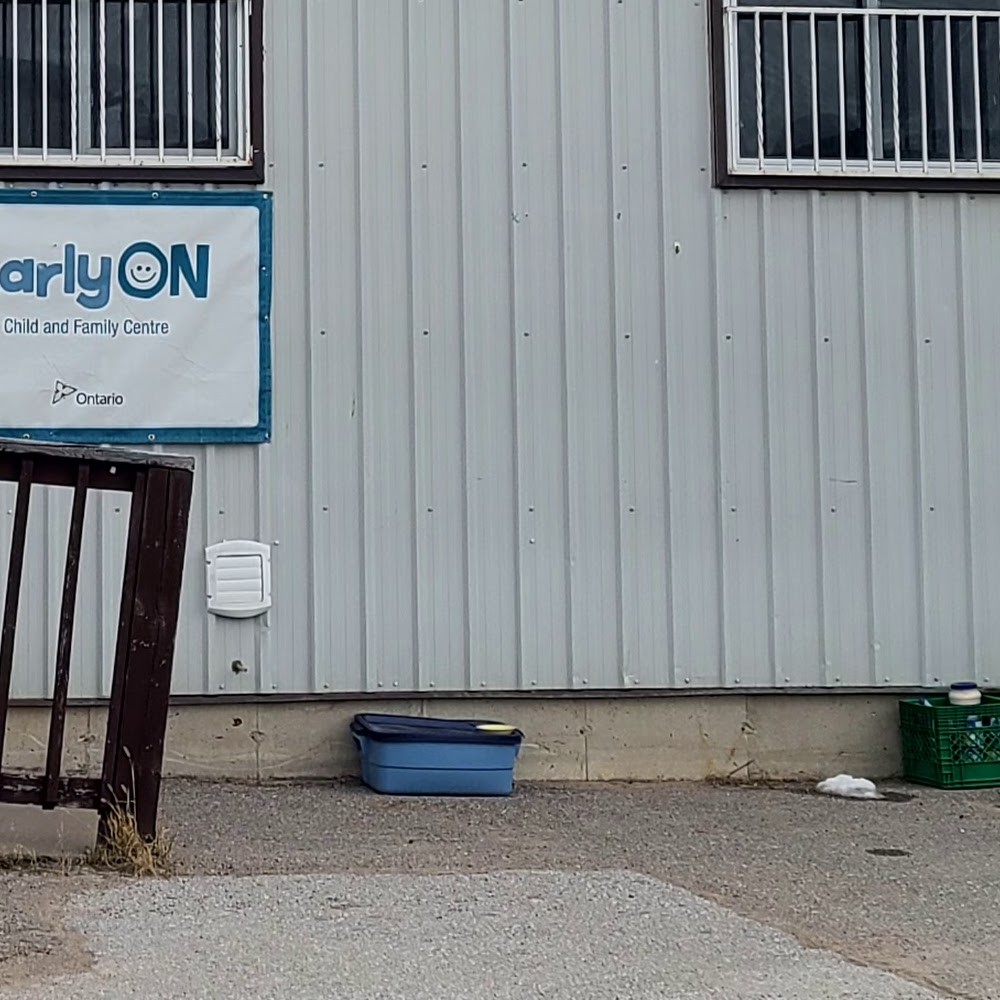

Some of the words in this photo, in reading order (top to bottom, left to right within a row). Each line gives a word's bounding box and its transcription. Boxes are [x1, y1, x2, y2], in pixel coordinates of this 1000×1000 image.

[4, 318, 38, 335] Child
[43, 319, 69, 335] and
[73, 319, 119, 337] Family
[123, 319, 169, 335] Centre
[76, 392, 124, 405] Ontario
